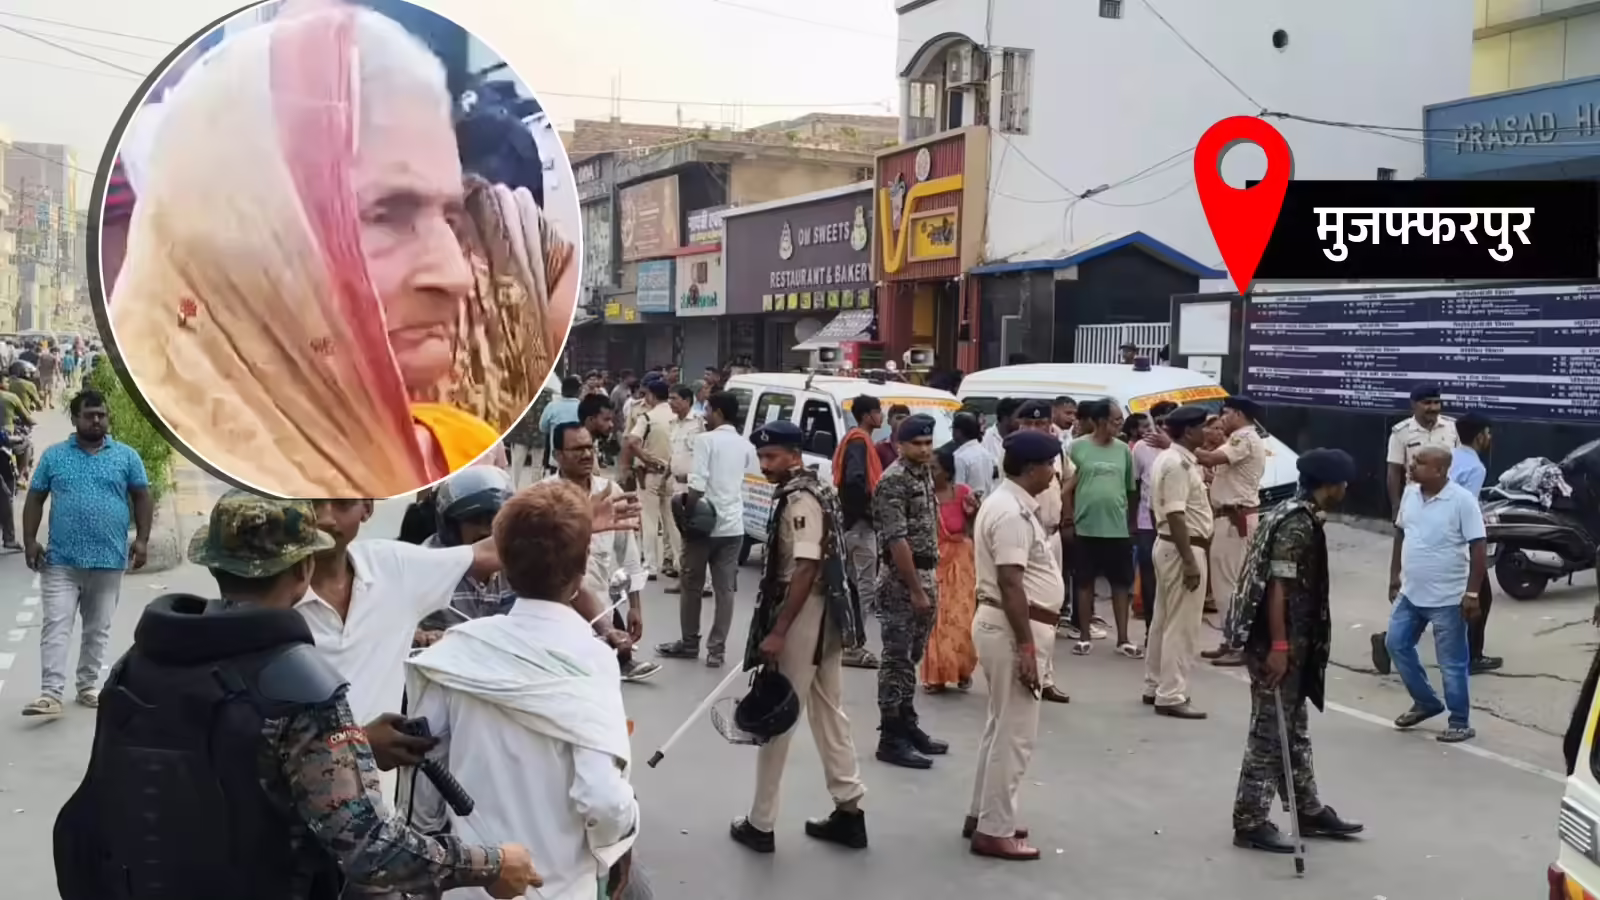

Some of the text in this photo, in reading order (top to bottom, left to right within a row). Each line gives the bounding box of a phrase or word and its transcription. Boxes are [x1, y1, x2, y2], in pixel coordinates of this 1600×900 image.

[1455, 111, 1558, 155] PRASAD
[798, 221, 850, 246] OM SWEETS
[770, 266, 825, 289] RESTAURANT
[826, 265, 833, 285] &
